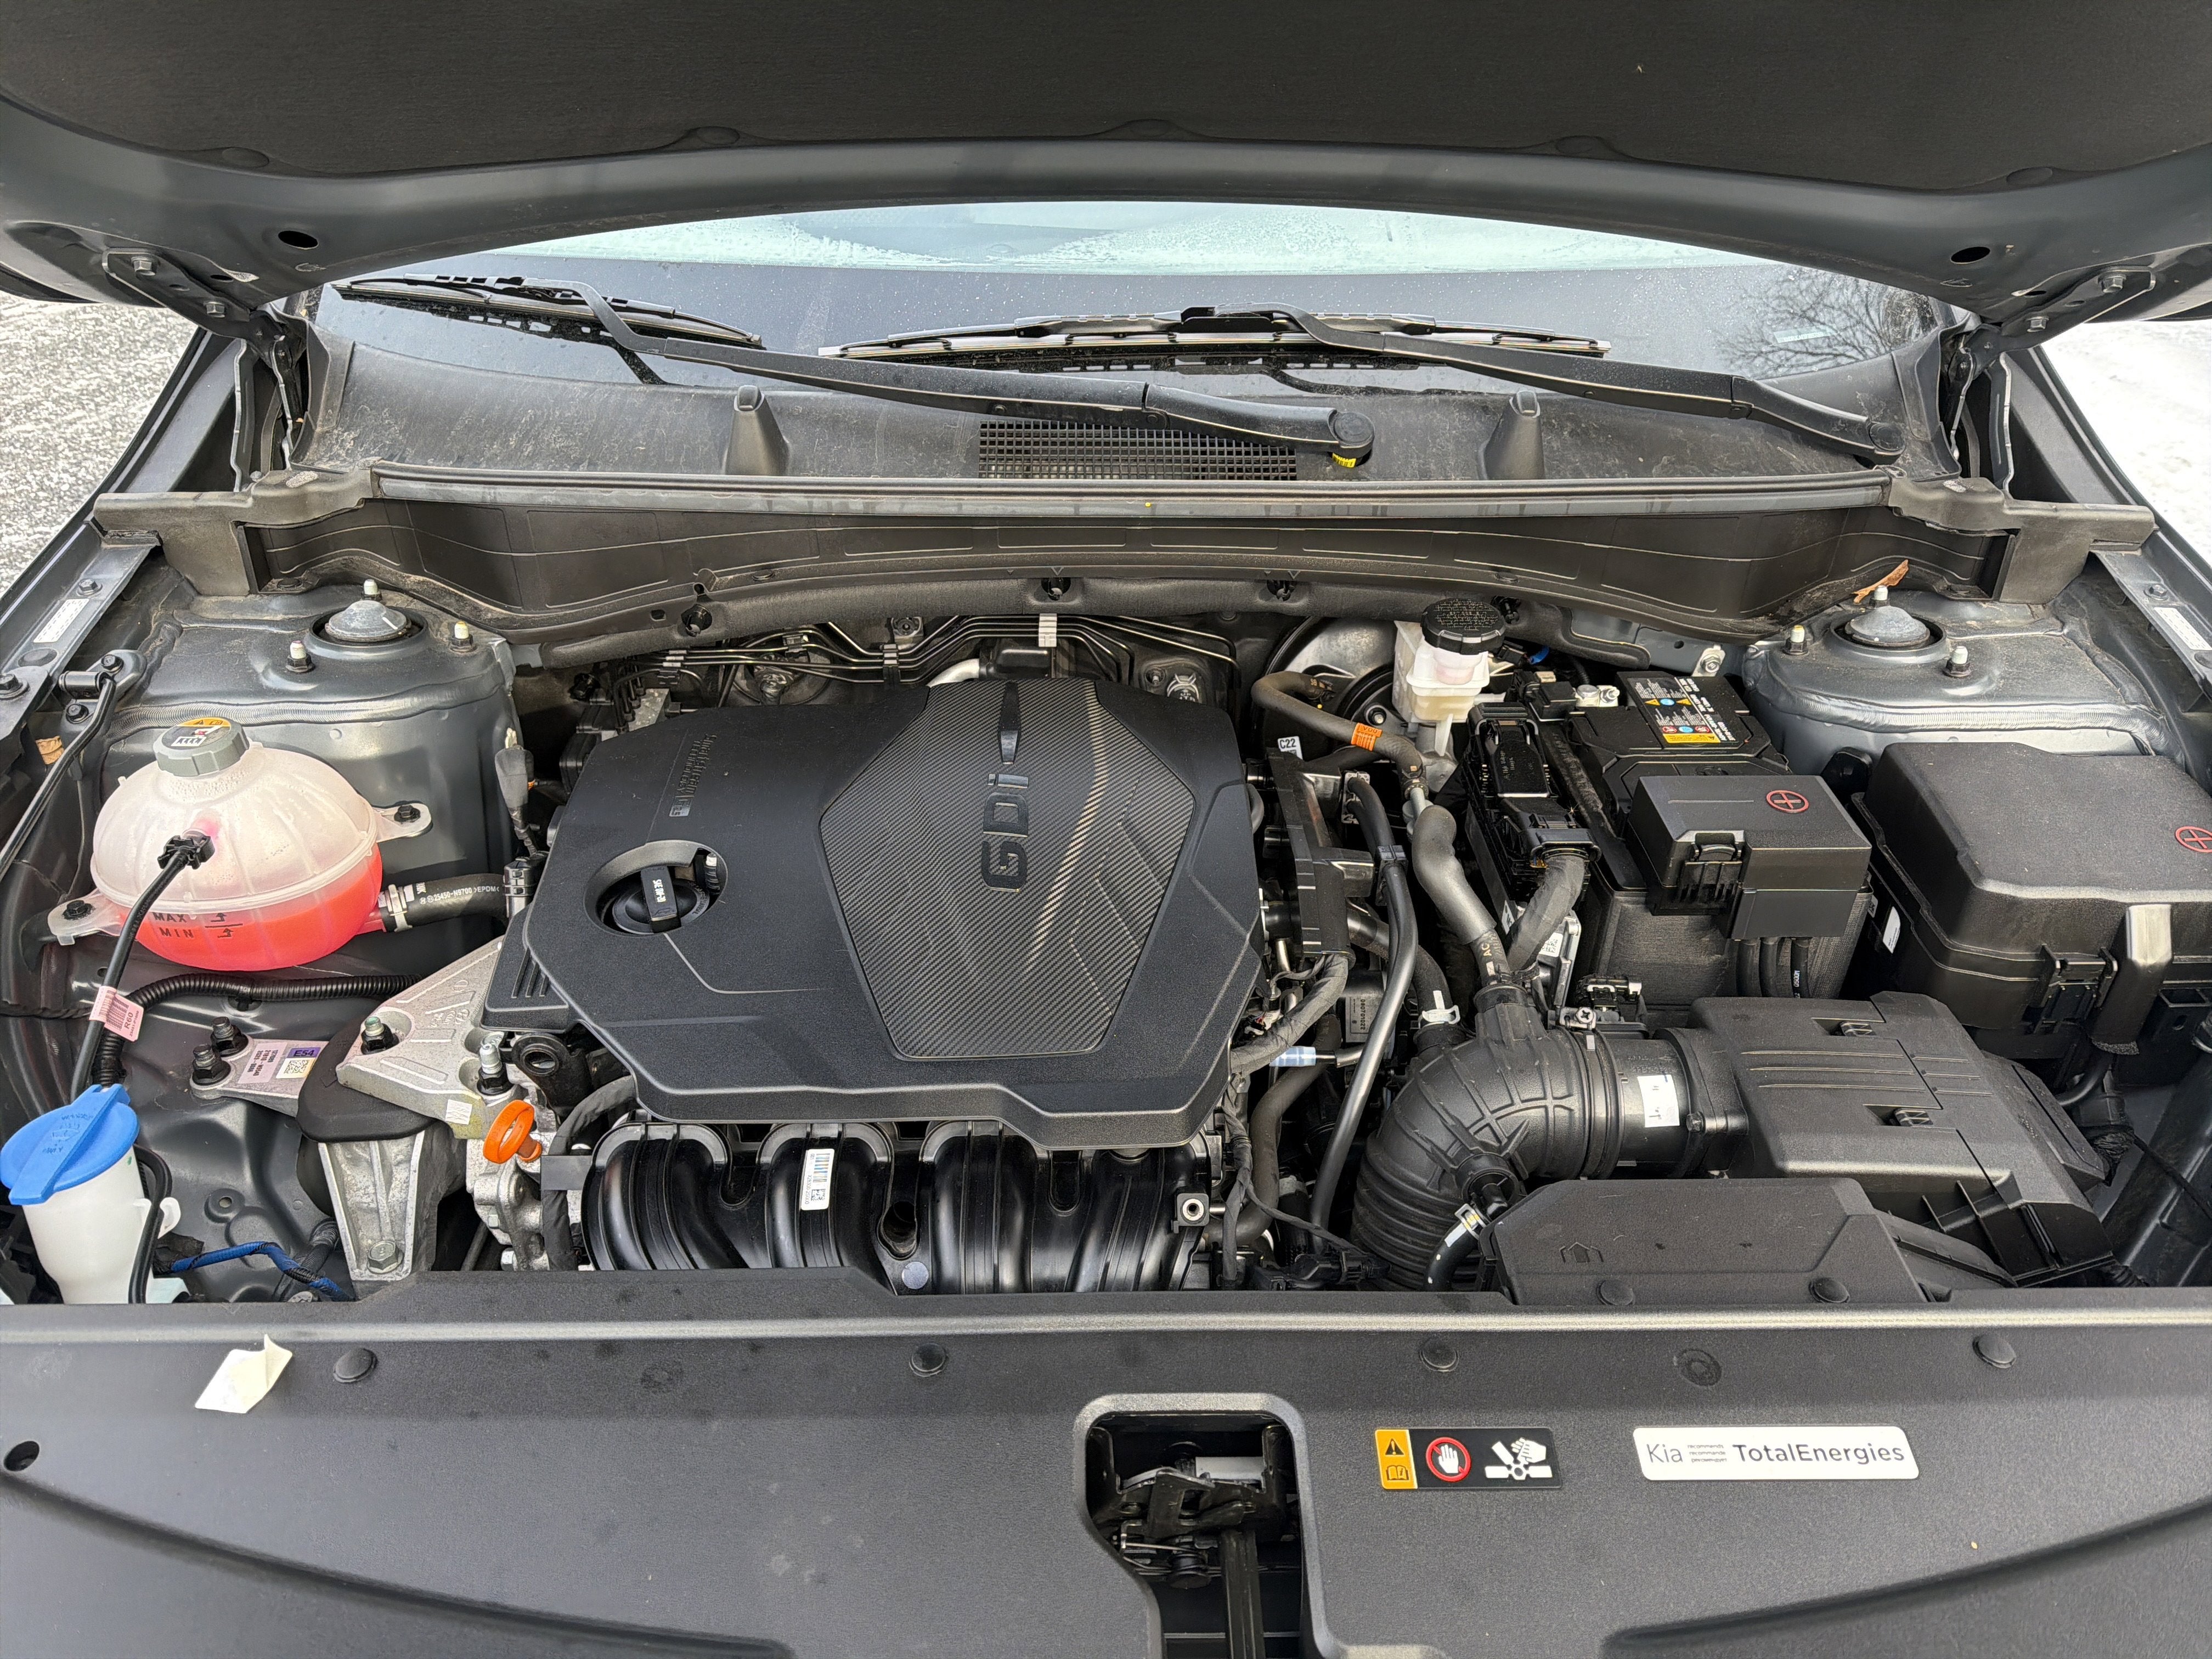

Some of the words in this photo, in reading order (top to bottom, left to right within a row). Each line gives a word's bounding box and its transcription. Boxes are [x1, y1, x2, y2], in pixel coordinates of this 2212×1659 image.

[1279, 738, 1296, 749] C22
[152, 912, 187, 923] MAX
[159, 927, 194, 938] MIN
[1481, 943, 1492, 957] AC
[124, 1012, 134, 1029] R60
[1646, 1443, 1683, 1463] Kia
[1731, 1443, 1905, 1465] TotalEnergies
